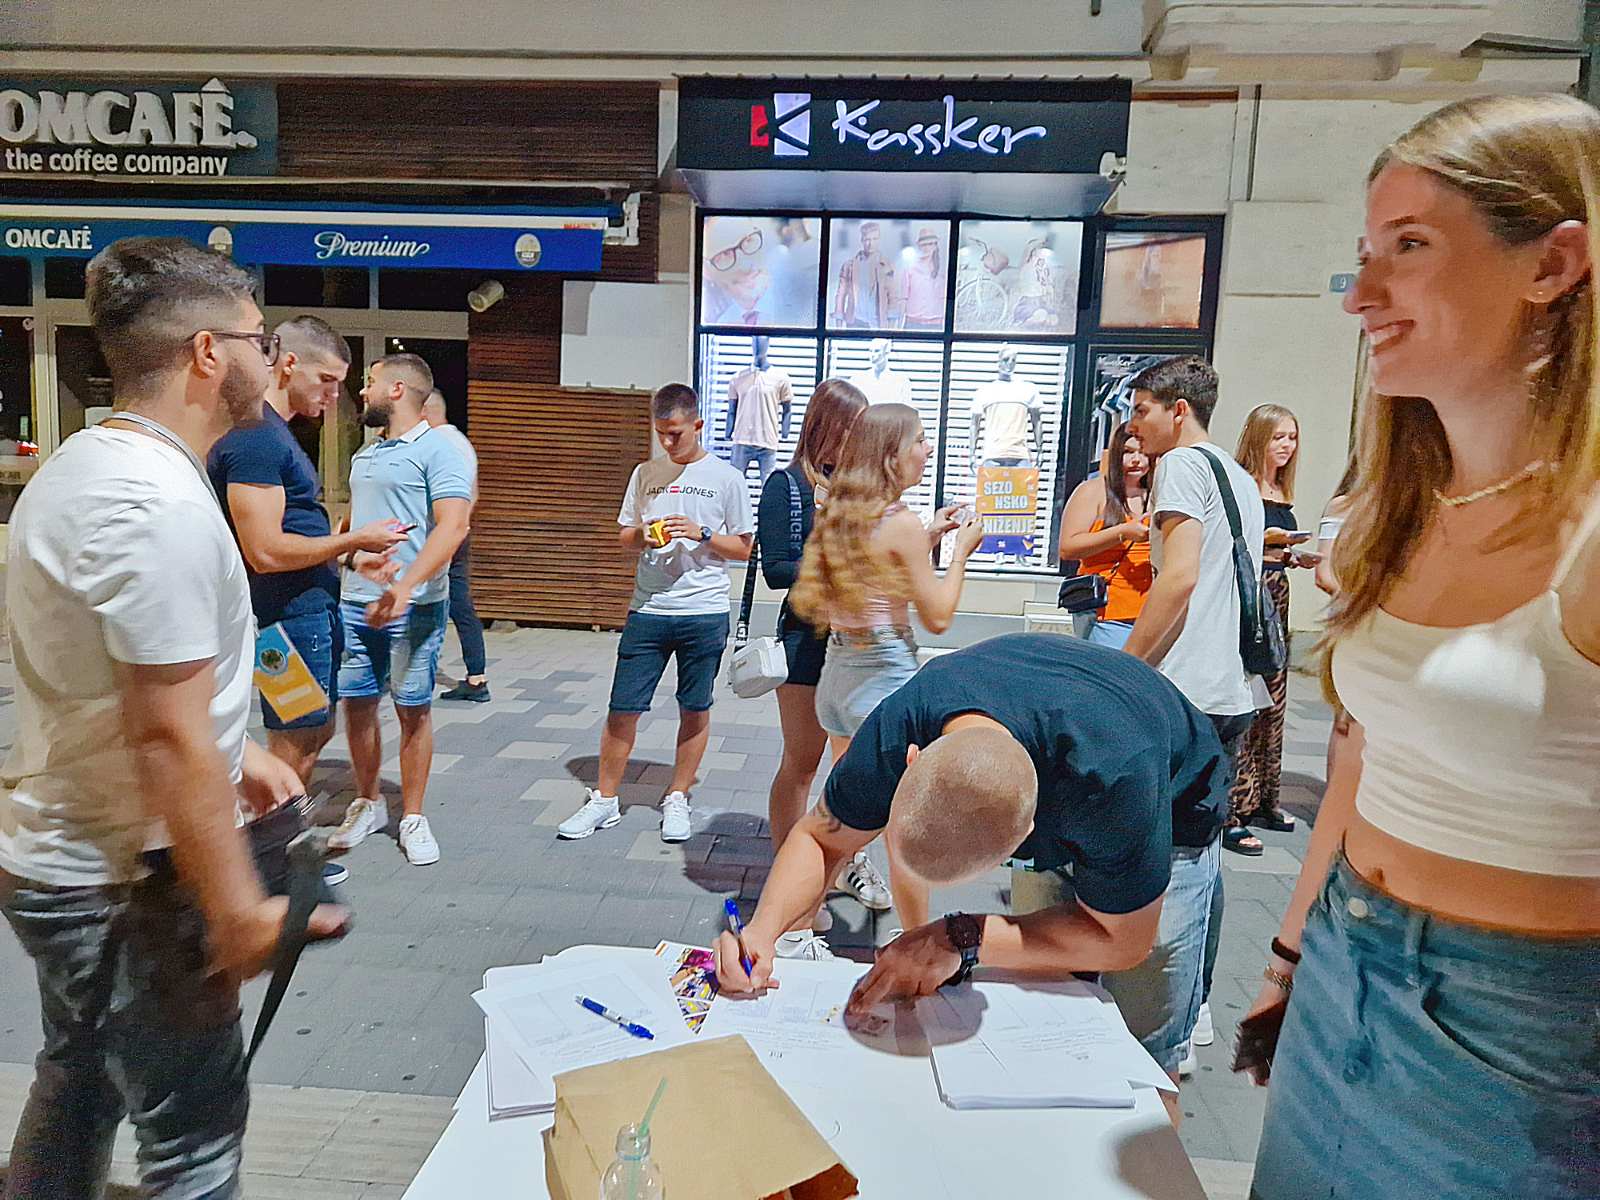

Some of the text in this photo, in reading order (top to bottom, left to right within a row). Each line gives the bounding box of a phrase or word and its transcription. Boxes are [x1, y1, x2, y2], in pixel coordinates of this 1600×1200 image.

[831, 95, 1047, 155] Kassker
[5, 147, 228, 177] the coffee company
[314, 231, 430, 260] Premium
[646, 486, 670, 496] JACK
